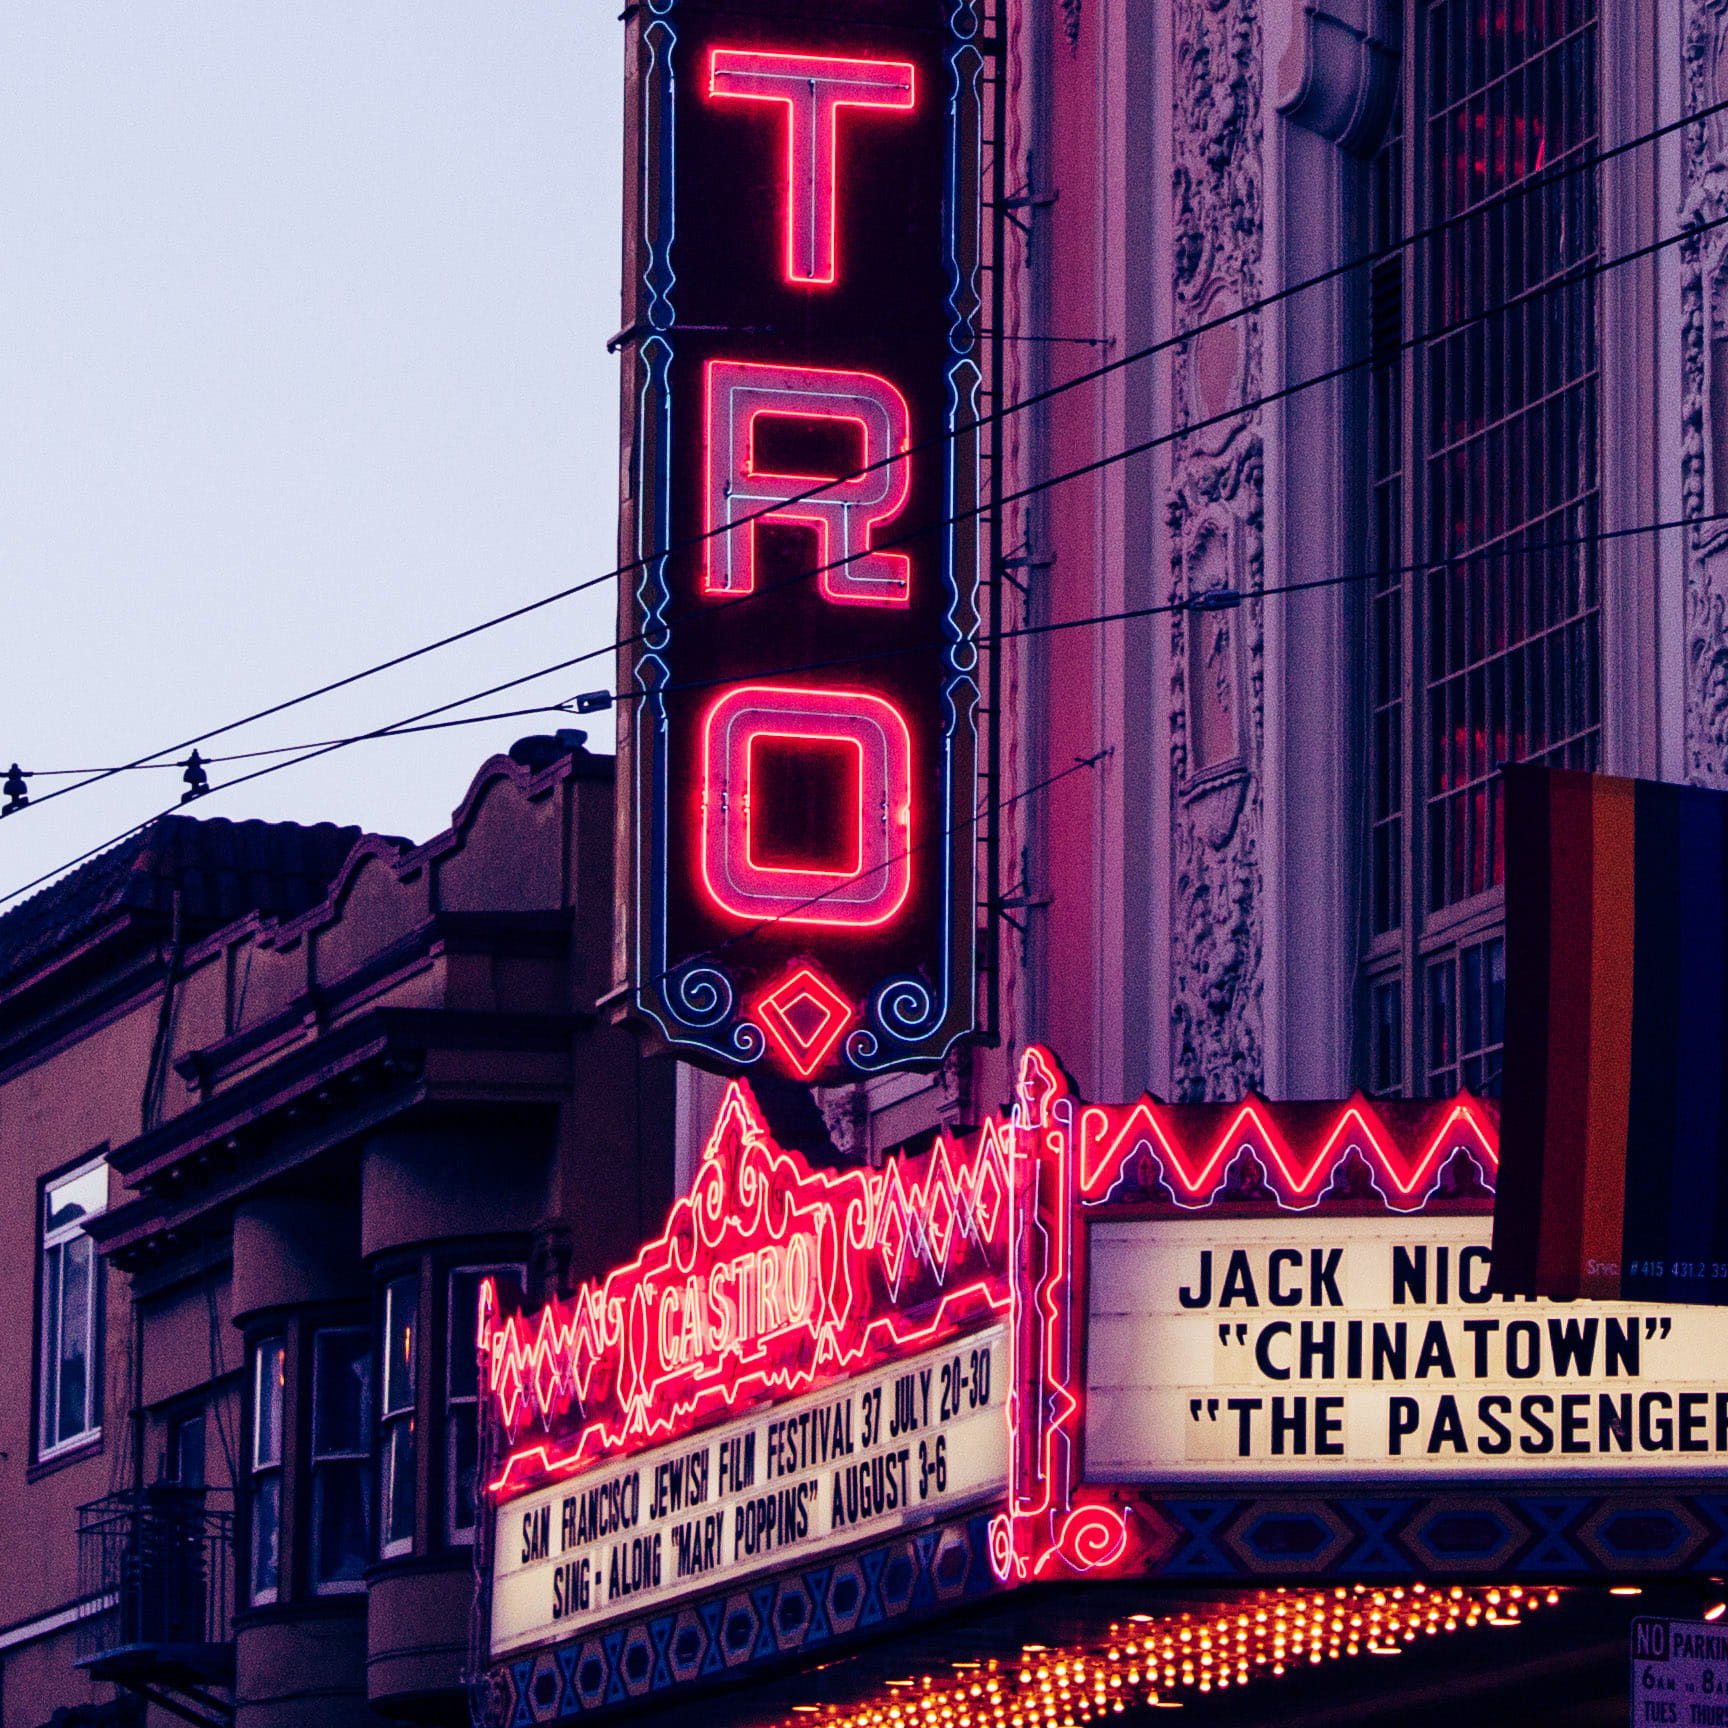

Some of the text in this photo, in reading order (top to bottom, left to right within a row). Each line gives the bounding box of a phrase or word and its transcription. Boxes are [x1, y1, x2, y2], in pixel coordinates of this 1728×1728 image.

[658, 1232, 813, 1371] CASTRO
[1177, 1247, 1344, 1309] JACK
[1218, 1316, 1673, 1381] "CHINATOWN"
[521, 1347, 991, 1564] SAN FRANCISCO JEWISH FILM FESTIVAL 37 JULY 20-30
[1189, 1396, 1345, 1457] "THE
[831, 1448, 910, 1529] AUGUST
[918, 1434, 947, 1500] 3-6
[1636, 1622, 1665, 1657] NO
[1644, 1700, 1677, 1724] TUES
